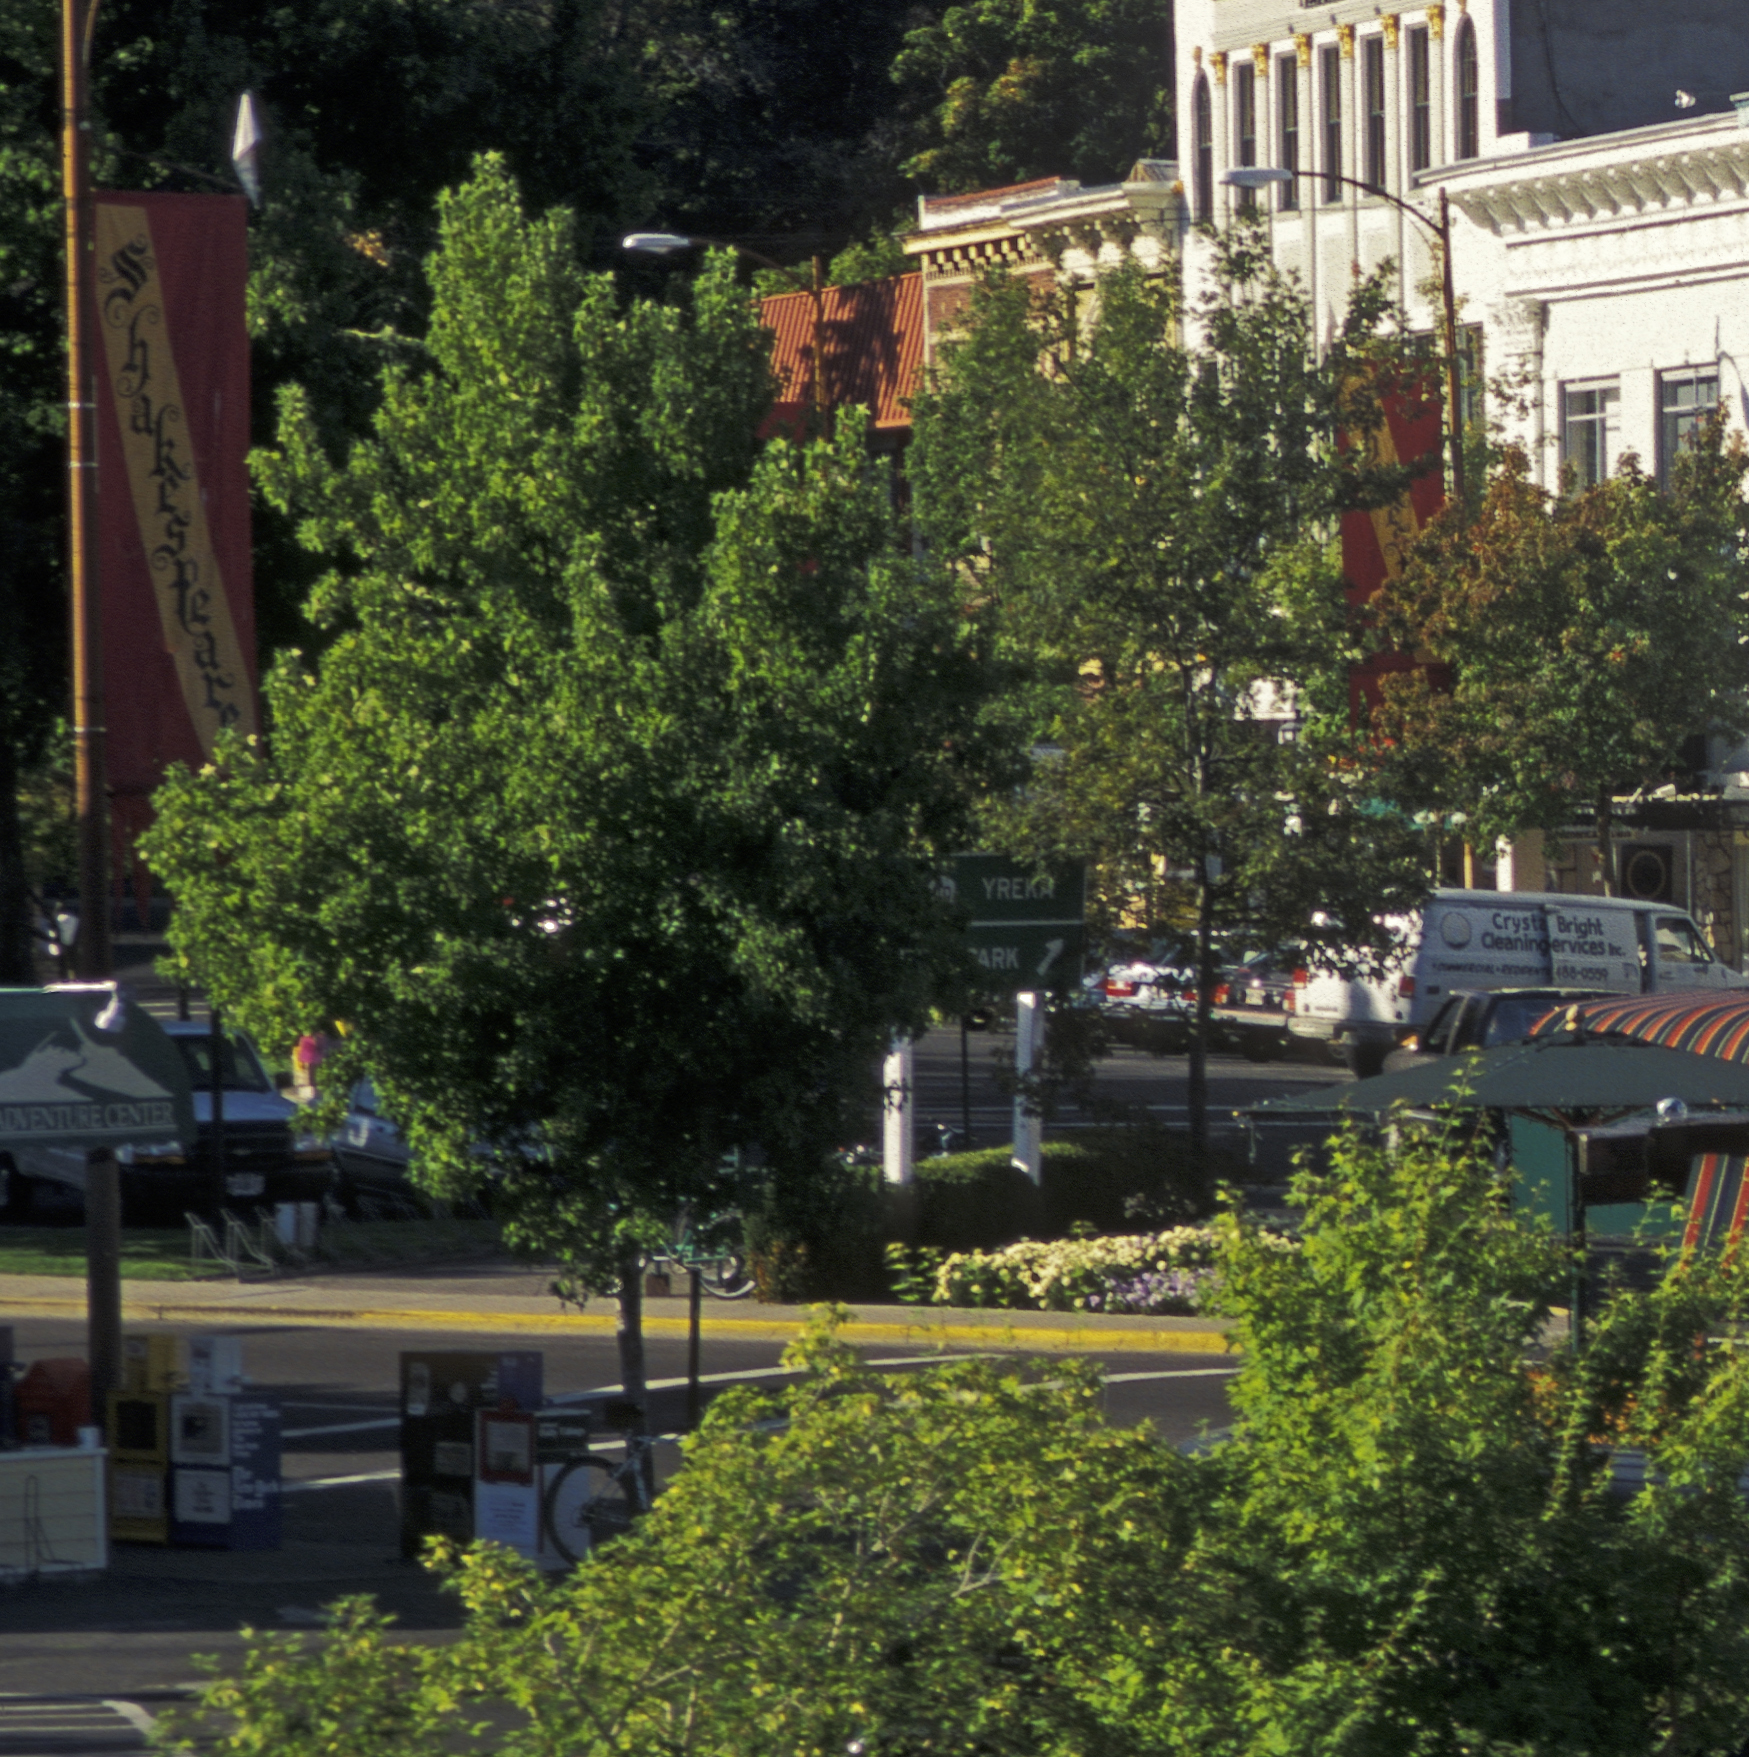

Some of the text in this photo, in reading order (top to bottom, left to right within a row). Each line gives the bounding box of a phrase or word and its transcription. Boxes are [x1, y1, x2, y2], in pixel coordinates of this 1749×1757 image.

[981, 876, 1055, 900] YREKA
[1491, 912, 1604, 939] Crysta Bright
[1550, 936, 1606, 955] ervices
[0, 1101, 174, 1130] DVENTURE CENTER
